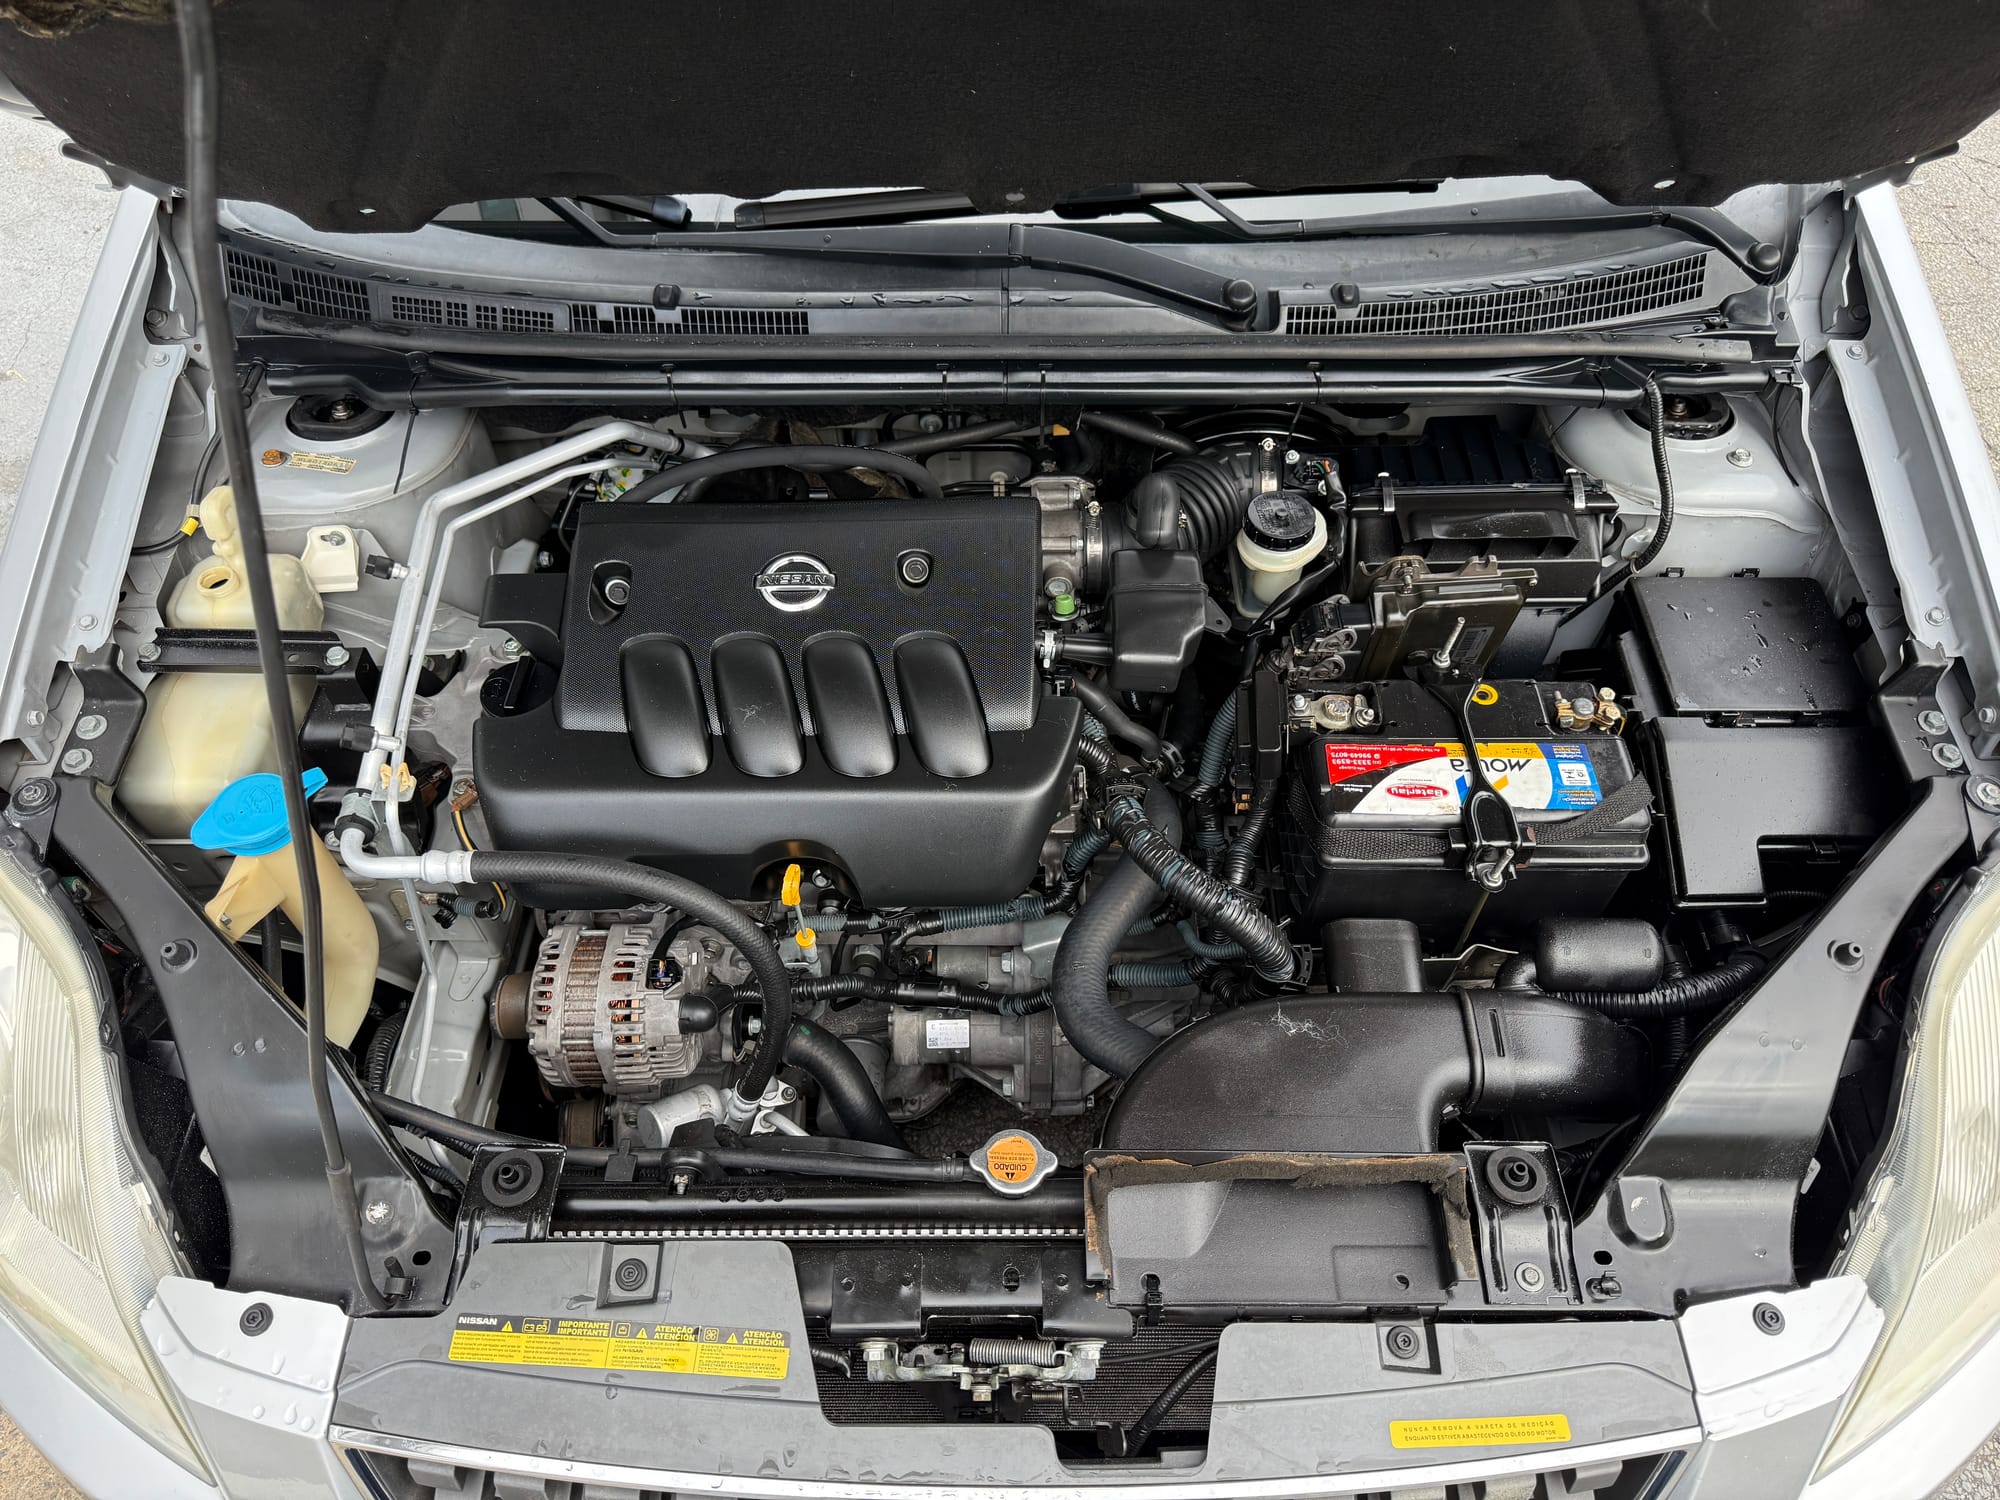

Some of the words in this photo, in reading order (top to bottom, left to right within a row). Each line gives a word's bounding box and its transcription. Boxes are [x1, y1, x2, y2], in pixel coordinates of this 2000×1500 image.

[763, 574, 827, 585] NISSAN
[1391, 787, 1444, 798] Baterlay
[993, 1162, 1027, 1172] CUIDADO
[458, 1316, 498, 1326] NISSAN
[558, 1320, 610, 1329] IMPORTANTE
[557, 1327, 609, 1337] IMPORTANTE
[743, 1330, 783, 1339] ATENÇÃO
[1404, 1434, 1436, 1442] ENQUANTO
[1462, 1432, 1504, 1440] ABASTECENDO
